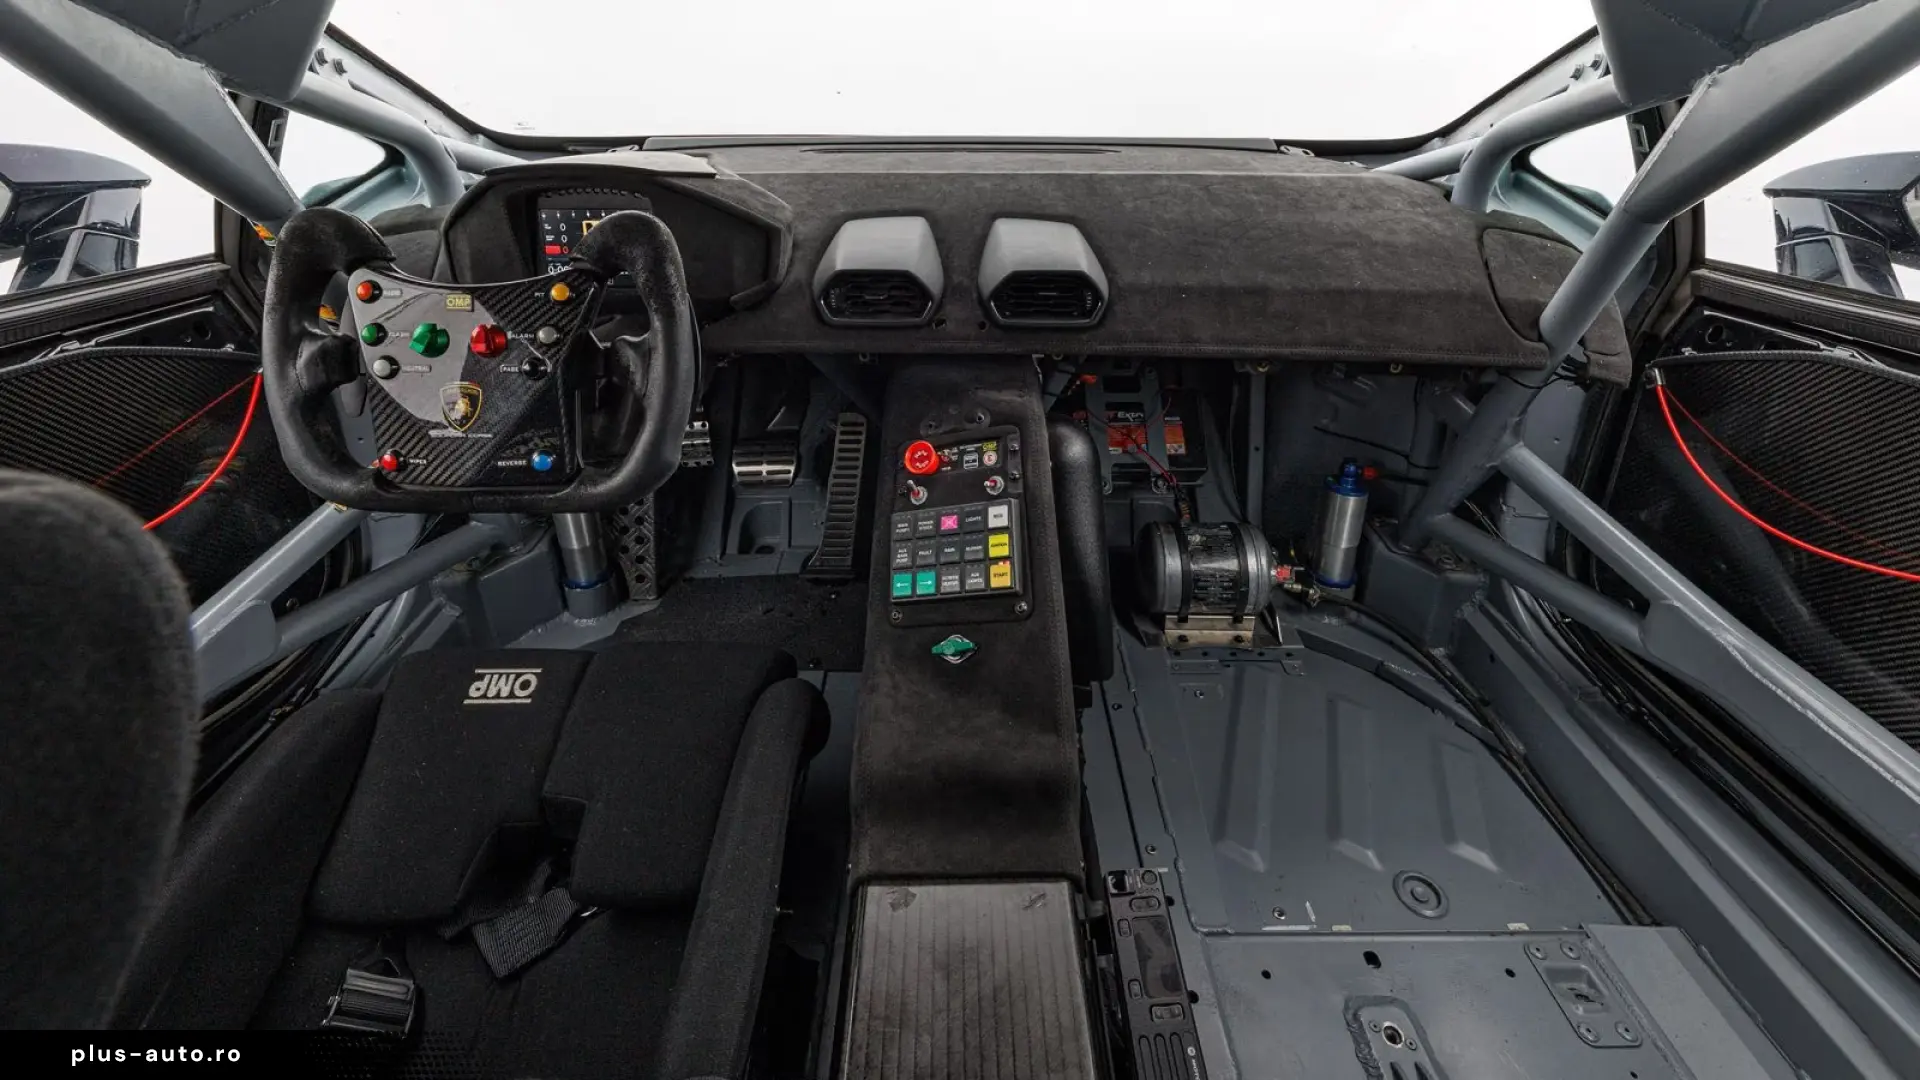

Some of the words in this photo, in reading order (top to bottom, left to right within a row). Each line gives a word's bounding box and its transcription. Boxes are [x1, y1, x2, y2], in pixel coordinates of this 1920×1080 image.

[446, 298, 470, 307] OMP
[497, 459, 528, 467] REVERSE
[467, 673, 538, 698] OMP
